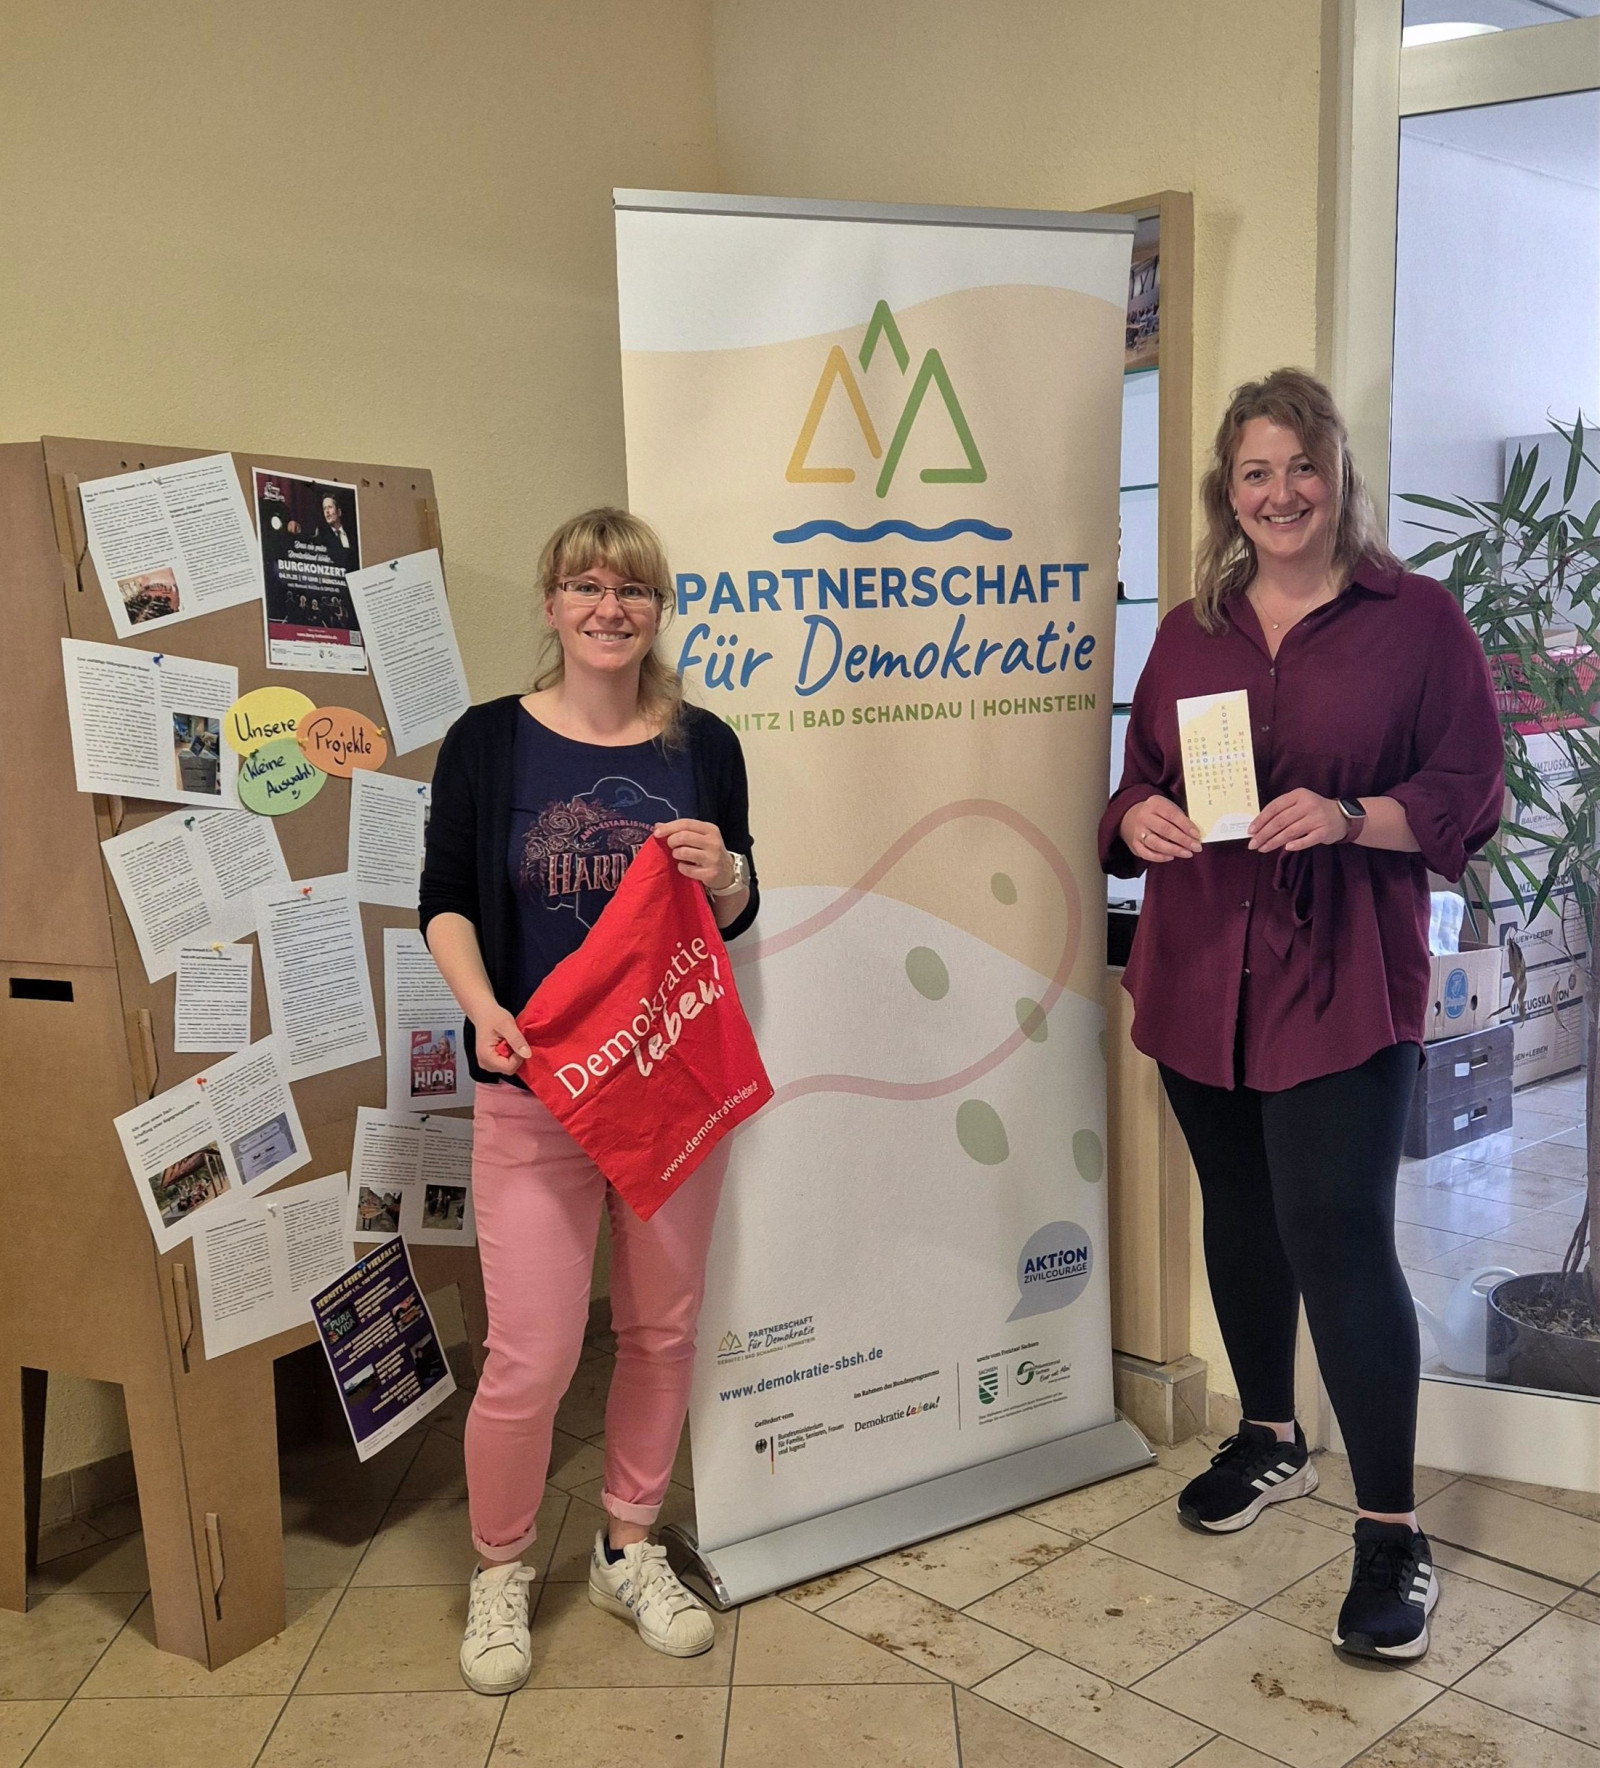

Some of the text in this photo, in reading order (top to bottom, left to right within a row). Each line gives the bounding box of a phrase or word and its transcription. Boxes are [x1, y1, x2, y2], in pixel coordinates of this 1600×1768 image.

[277, 559, 347, 578] BURGKONZERT
[676, 563, 1089, 615] PARTNERSCHAFT
[676, 614, 1096, 696] für Demokratie
[726, 711, 780, 732] NITZ
[803, 709, 846, 728] BAD
[852, 701, 962, 725] SCHANDAU
[983, 694, 1096, 717] HOHNSTEIN
[234, 713, 297, 742] Unsere
[307, 717, 372, 765] Projekte
[266, 763, 316, 798] Auswahl)
[548, 852, 629, 896] HARD
[553, 937, 710, 1100] Demokratie
[414, 1069, 455, 1088] HIOB
[1024, 1262, 1088, 1284] ZIVILCOURAGE
[329, 1311, 353, 1331] PURA
[335, 1318, 356, 1336] VIDA
[748, 1315, 813, 1339] PARTNERSCHAFT
[747, 1326, 815, 1352] für Demokratie
[719, 1348, 884, 1402] www.demokratie-sbsh.de
[978, 1365, 998, 1376] SACHSEN
[861, 1386, 883, 1397] Rahmen
[854, 1409, 905, 1433] Demokratie
